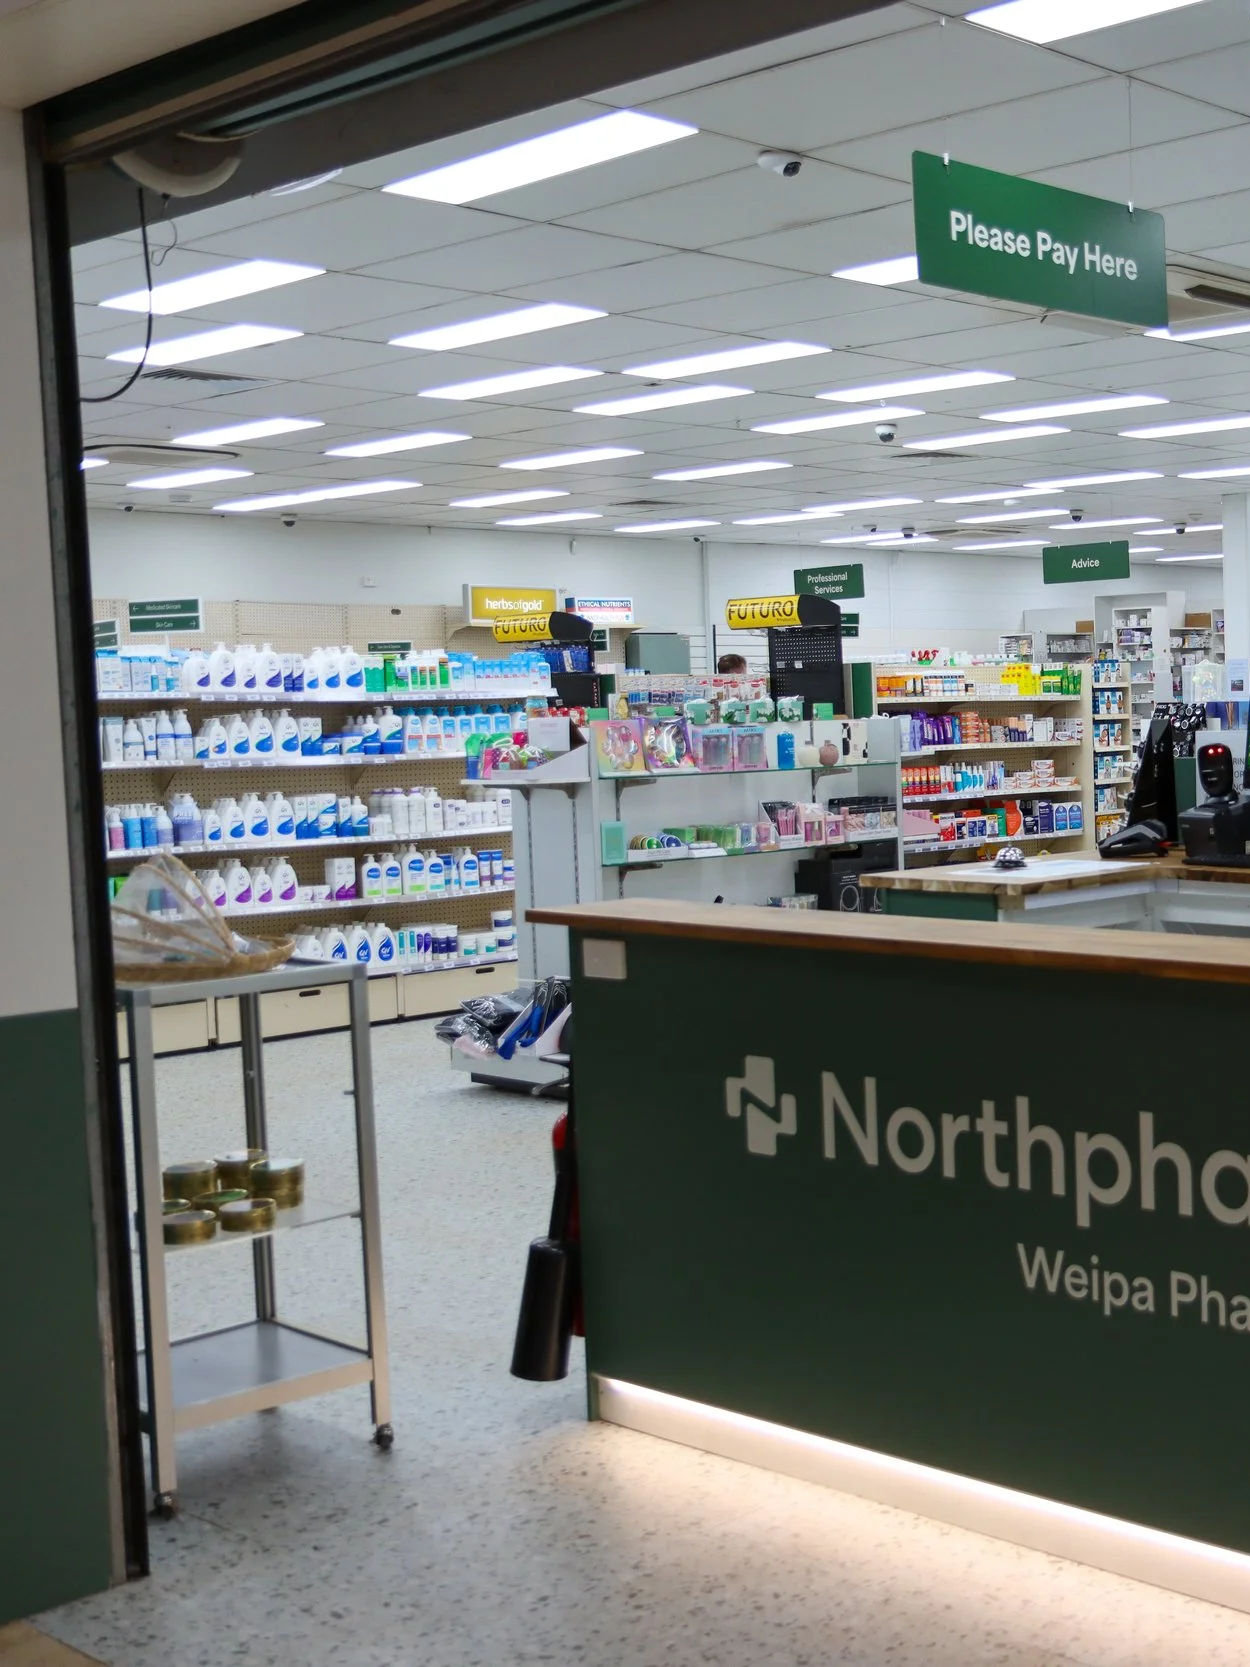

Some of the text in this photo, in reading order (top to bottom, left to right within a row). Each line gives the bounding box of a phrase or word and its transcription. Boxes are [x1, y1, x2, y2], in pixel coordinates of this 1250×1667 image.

[950, 210, 1138, 281] Please Pay Here
[1071, 557, 1100, 569] Advice
[807, 571, 848, 584] Professional
[814, 585, 844, 595] Services
[485, 598, 543, 612] herbsofgold
[728, 600, 795, 621] FUTURO
[495, 616, 547, 635] FUTURO
[1017, 1242, 1155, 1315] Weipa
